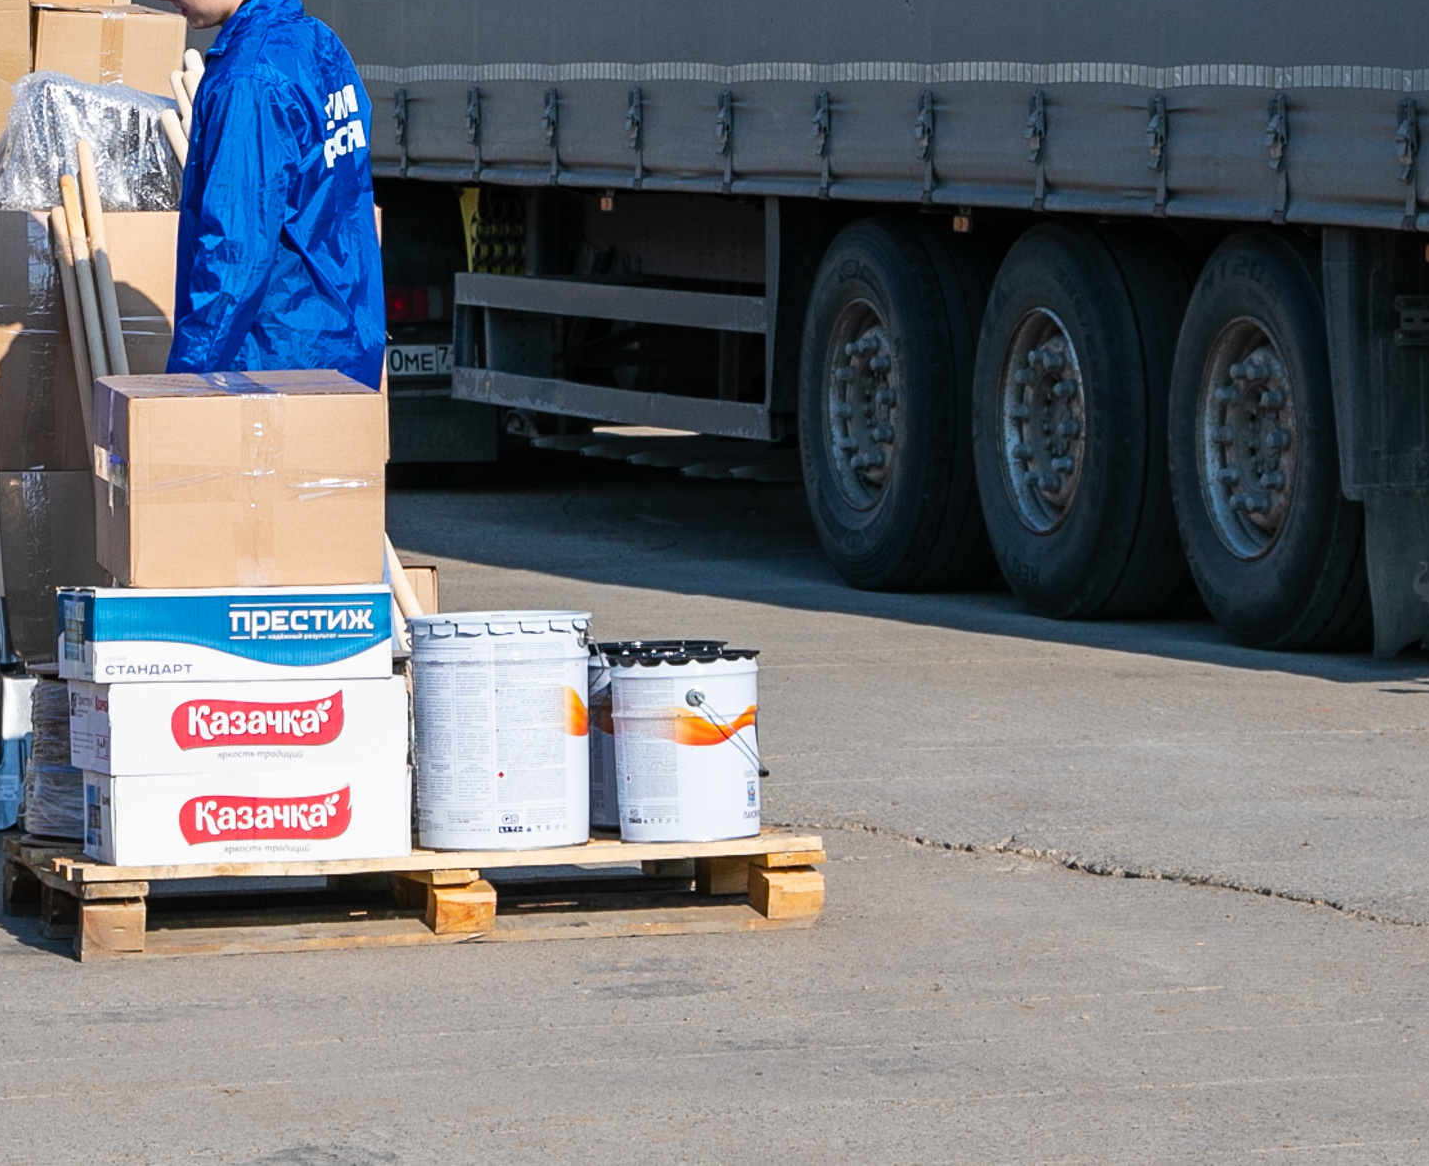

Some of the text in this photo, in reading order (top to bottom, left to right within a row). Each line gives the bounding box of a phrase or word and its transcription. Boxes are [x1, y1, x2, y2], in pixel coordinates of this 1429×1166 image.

[228, 608, 375, 640] ПРЕСТИЖ
[105, 664, 194, 676] СТАНДАРТ
[187, 704, 321, 741] Казачка
[217, 749, 304, 760] яркость традиций
[195, 800, 328, 836] Казачка
[223, 843, 311, 854] яркость традиций
